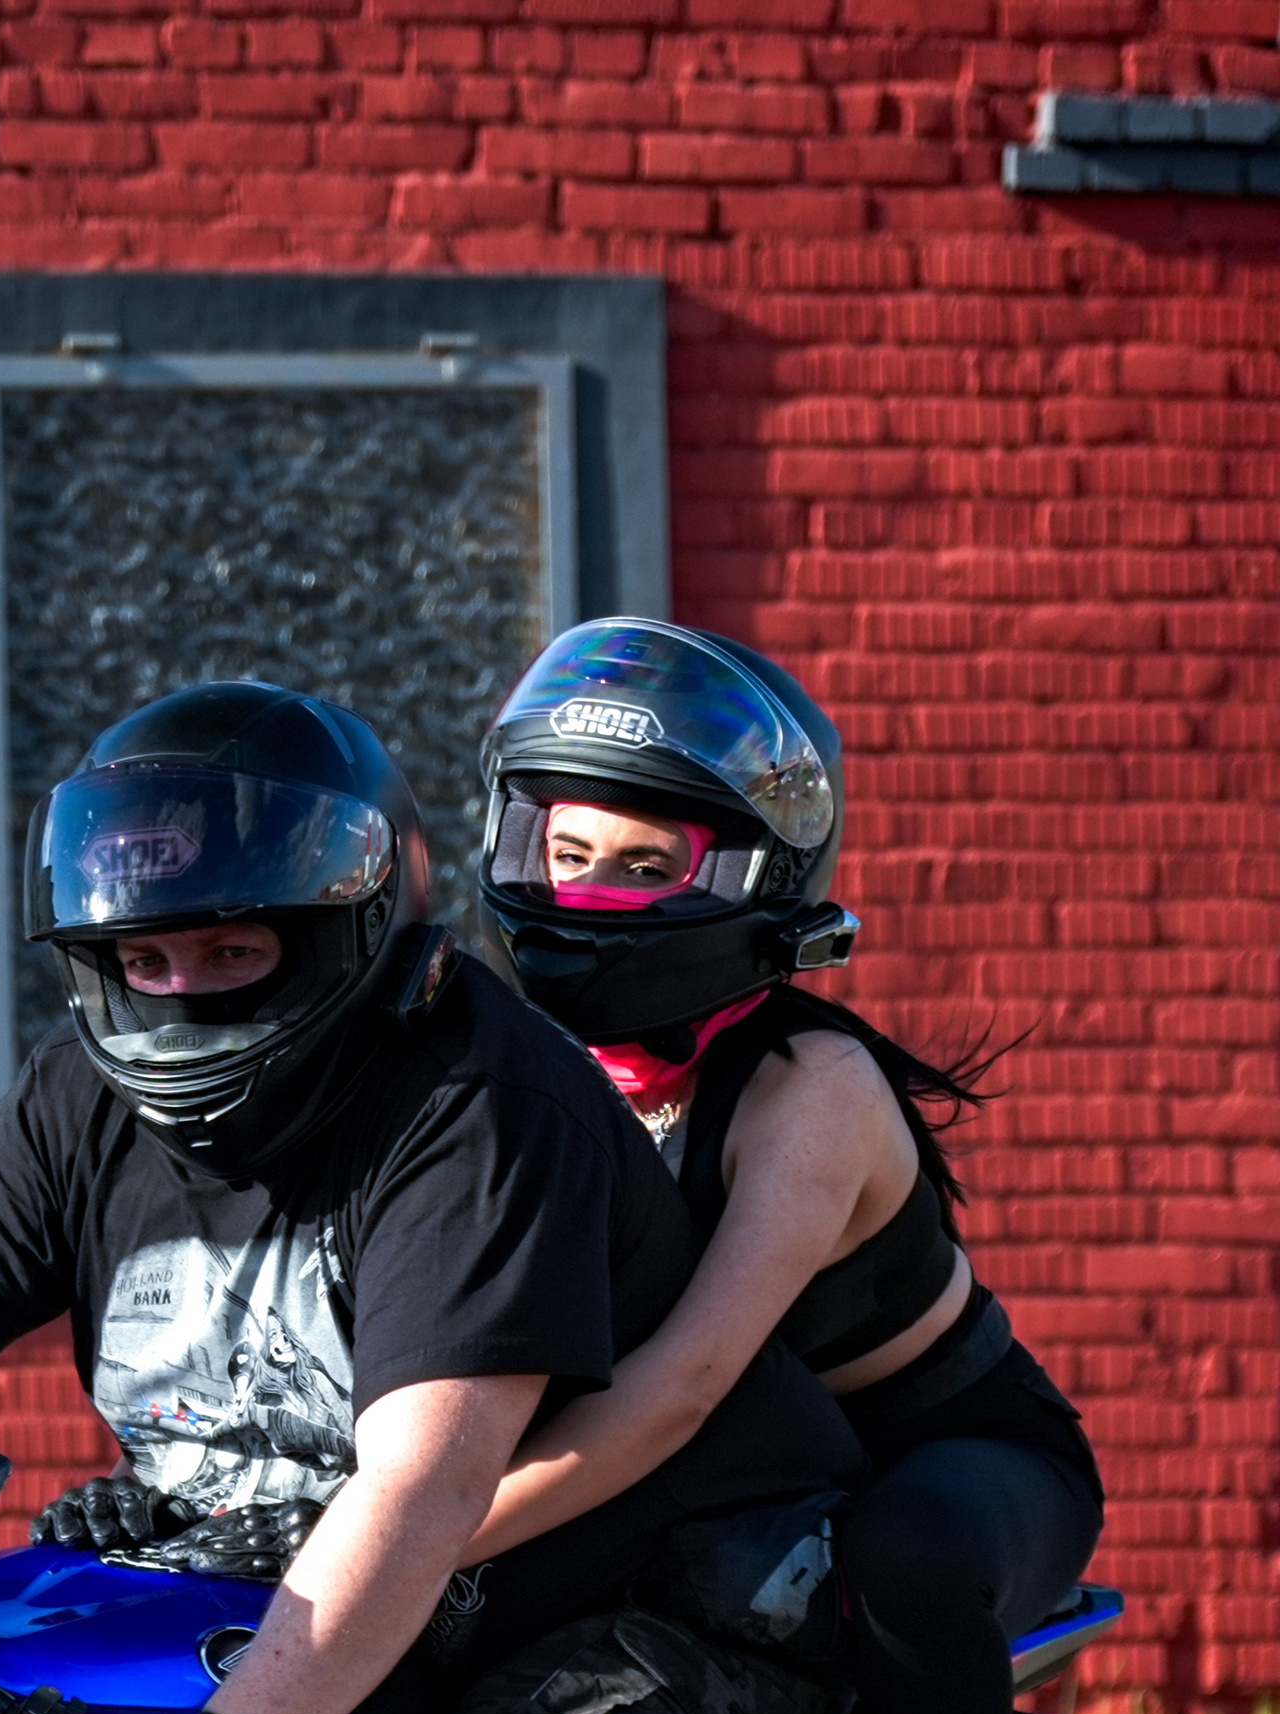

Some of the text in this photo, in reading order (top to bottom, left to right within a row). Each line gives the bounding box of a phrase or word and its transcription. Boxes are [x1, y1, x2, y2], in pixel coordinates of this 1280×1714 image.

[559, 703, 651, 743] SHOEI
[92, 836, 180, 874] SHOEI
[158, 1034, 198, 1050] SHOEI
[133, 1287, 172, 1306] BANK
